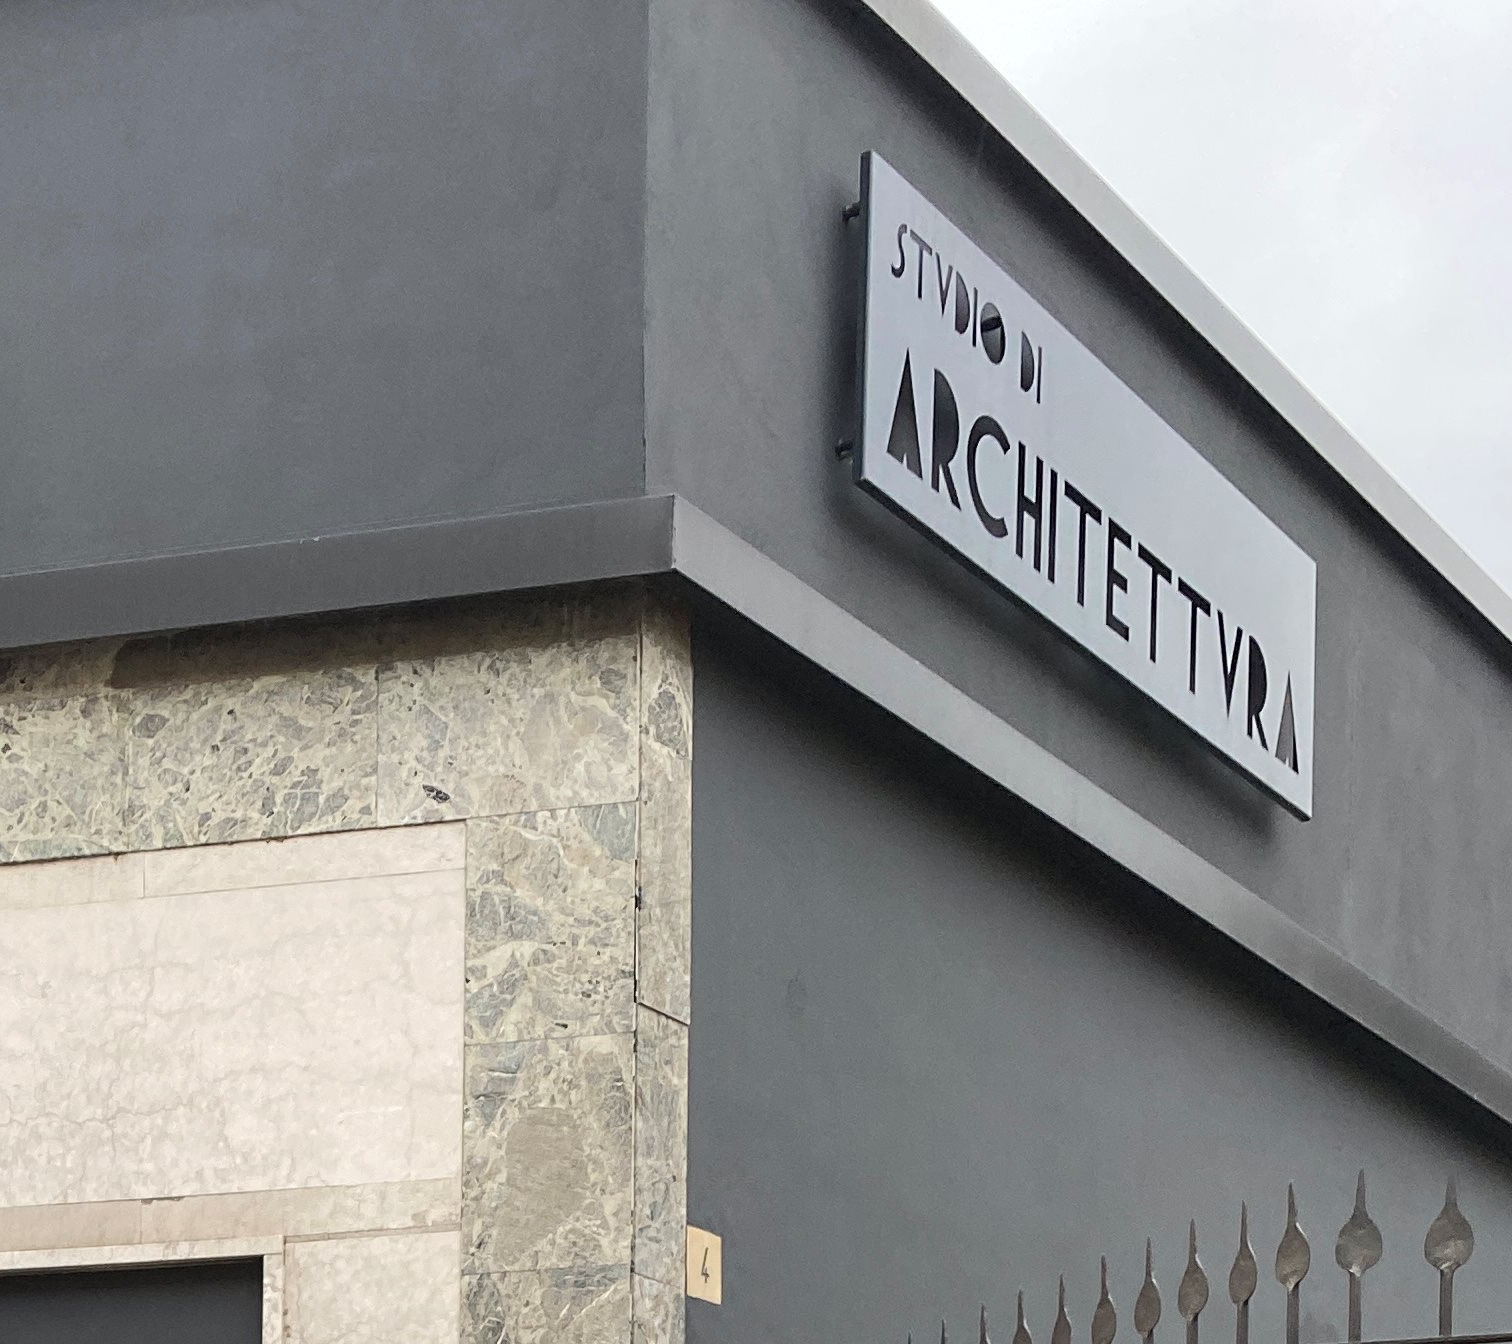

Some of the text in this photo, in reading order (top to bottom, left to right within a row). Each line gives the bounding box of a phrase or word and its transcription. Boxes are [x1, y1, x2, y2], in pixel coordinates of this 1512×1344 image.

[890, 223, 1043, 404] STVDIO DI
[886, 347, 1299, 775] ARCHITETTVRA
[700, 1246, 710, 1285] 4
